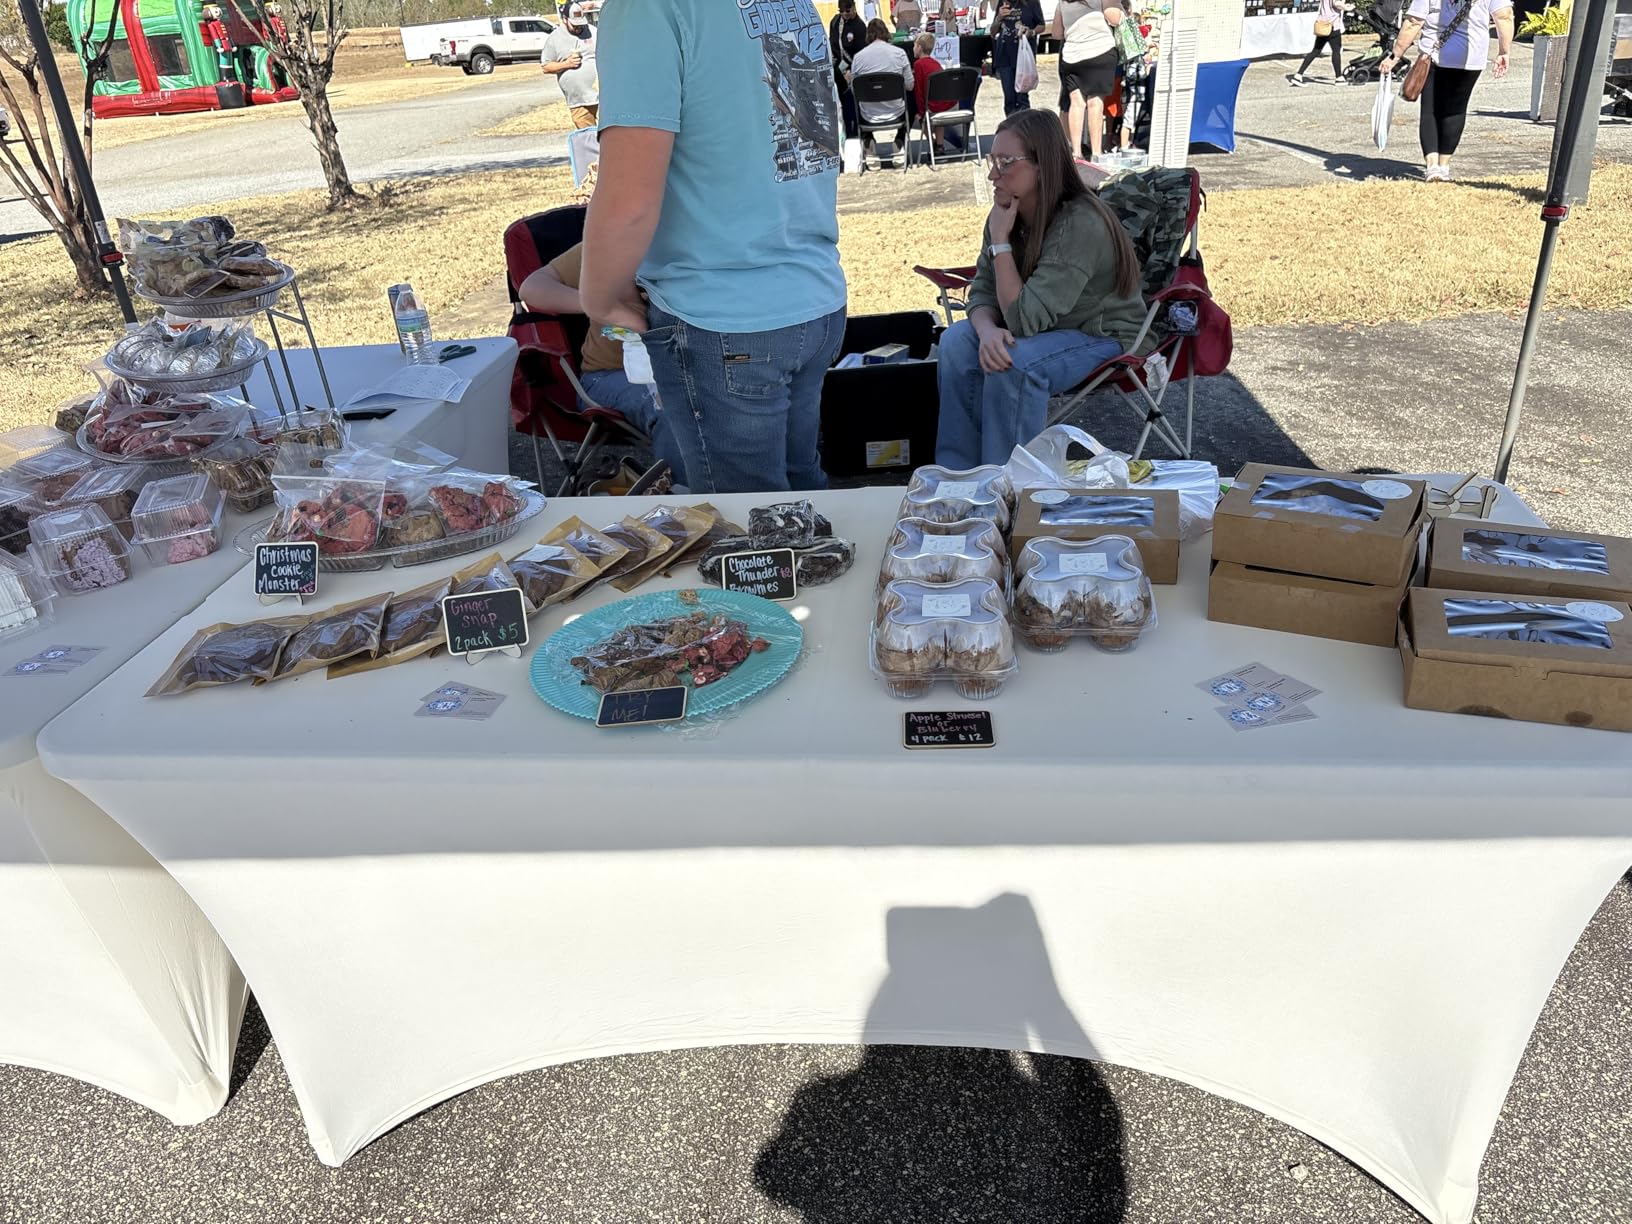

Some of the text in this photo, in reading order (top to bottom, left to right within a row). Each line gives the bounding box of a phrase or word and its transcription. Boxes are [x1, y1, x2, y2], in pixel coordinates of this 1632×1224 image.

[798, 25, 829, 62] 12
[260, 546, 312, 565] Christmas
[728, 555, 774, 573] Chocolate
[258, 573, 300, 593] Monster
[734, 566, 780, 583] Thunder
[450, 597, 493, 616] Ginger
[497, 622, 519, 641] $5
[909, 713, 942, 725] Apple
[910, 735, 920, 744] 4
